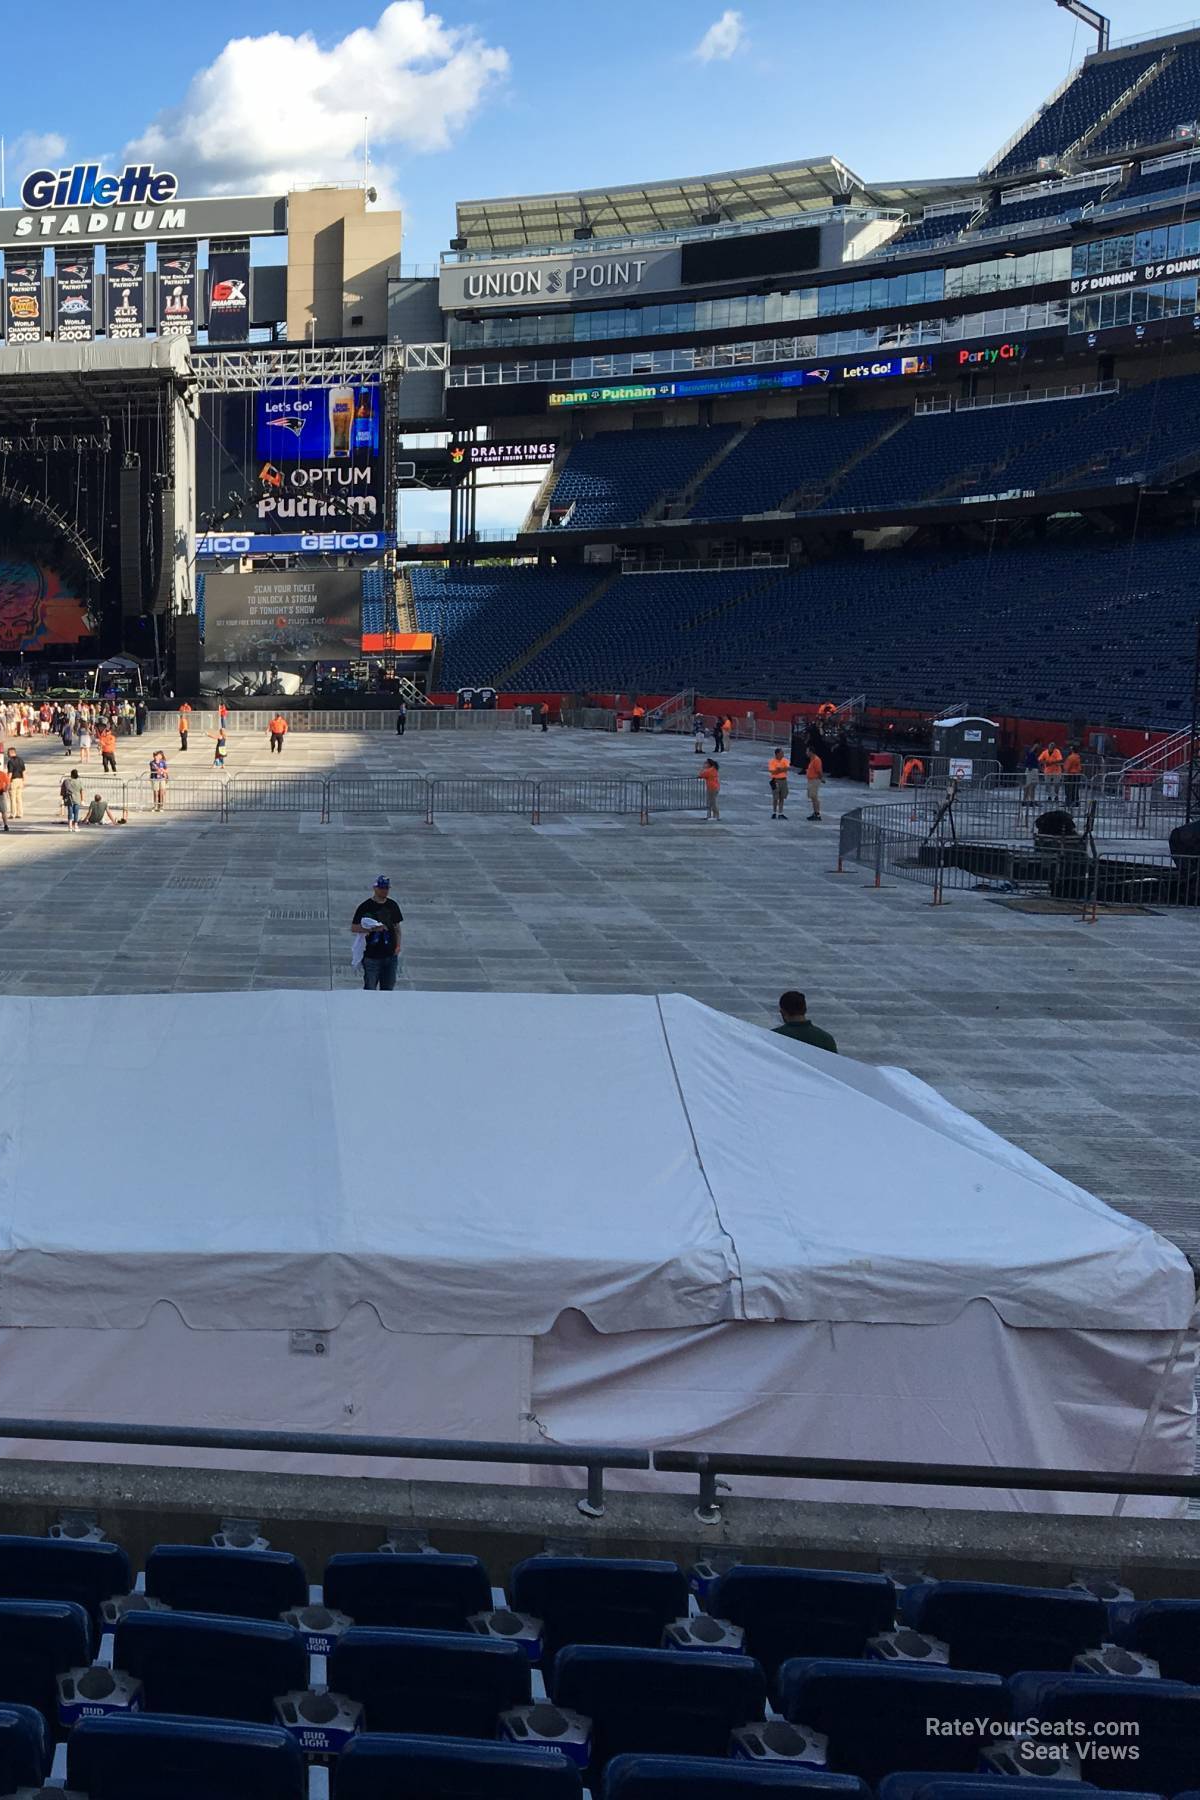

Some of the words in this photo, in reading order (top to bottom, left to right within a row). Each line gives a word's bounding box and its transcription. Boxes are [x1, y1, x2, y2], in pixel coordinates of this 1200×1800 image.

[21, 164, 178, 209] Gillette
[15, 209, 186, 236] STADIUM
[1166, 258, 1200, 274] DUNK
[468, 270, 541, 296] UNION
[573, 260, 646, 288] POINT
[1090, 270, 1137, 289] DUNKIN'
[115, 308, 137, 316] XLIX
[9, 332, 40, 342] 2003
[60, 331, 91, 340] 2004
[111, 329, 140, 338] 2014
[162, 326, 192, 336] 2016
[959, 348, 998, 363] Party
[843, 365, 869, 378] Let's
[871, 362, 891, 374] Go!
[550, 391, 587, 403] tnam
[602, 386, 657, 400] Putnam
[265, 401, 290, 413] Let's
[293, 400, 313, 412] Go!
[471, 443, 556, 457] DRAFTKINGS
[290, 466, 372, 487] OPTUM
[196, 538, 250, 553] EICO
[301, 533, 378, 550] GEICO
[254, 585, 272, 594] SCAN
[274, 584, 292, 593] YOUR
[293, 583, 315, 592] TICKET
[247, 596, 256, 604] TO
[257, 595, 283, 604] UNLOCK
[285, 595, 290, 603] A
[291, 594, 318, 603] STREAM
[249, 606, 258, 615] OF
[259, 606, 294, 614] TONIGHT'S
[295, 605, 315, 614] SHOW
[82, 1706, 105, 1716] BUD
[303, 1731, 326, 1740] BUD
[299, 1738, 330, 1748] LIGHT
